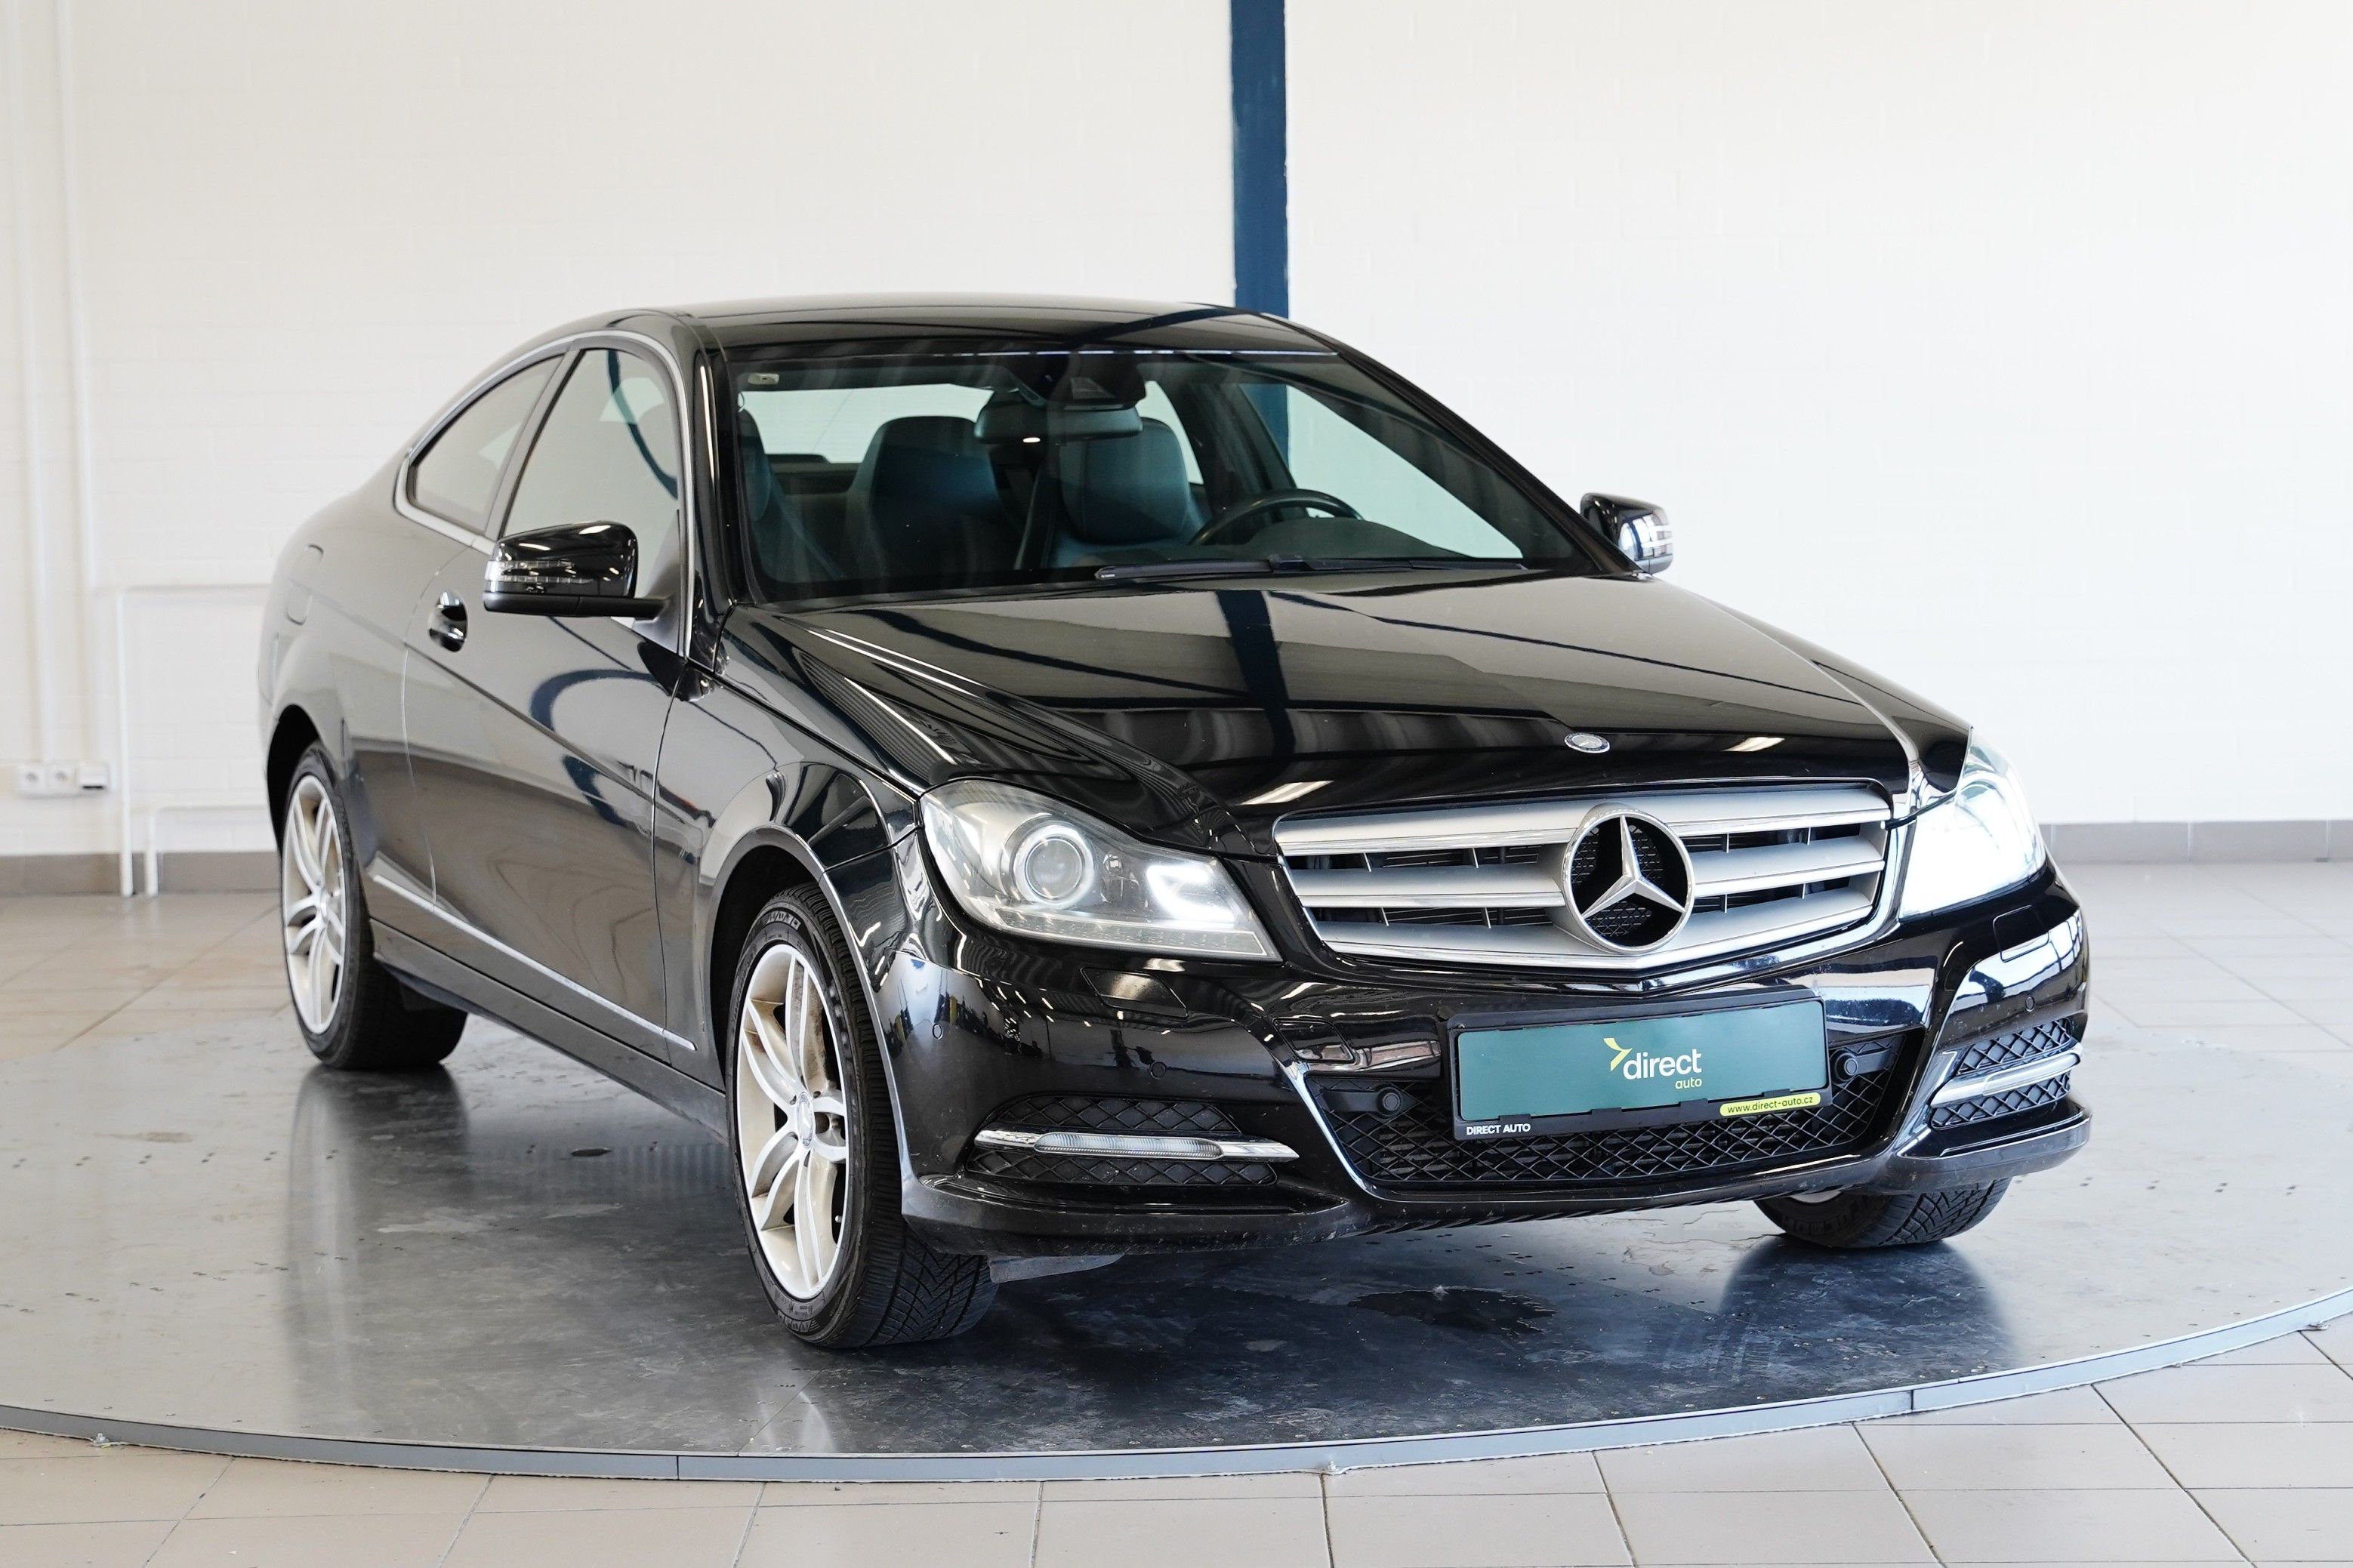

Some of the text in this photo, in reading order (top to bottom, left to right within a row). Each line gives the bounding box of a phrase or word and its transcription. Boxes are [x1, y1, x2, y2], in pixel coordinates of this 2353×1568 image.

[1623, 1049, 1702, 1080] direct
[1675, 1077, 1702, 1089] auto
[1727, 1096, 1813, 1113] www.direct-auto.cz
[1466, 1123, 1531, 1135] DIRECT AUTO
